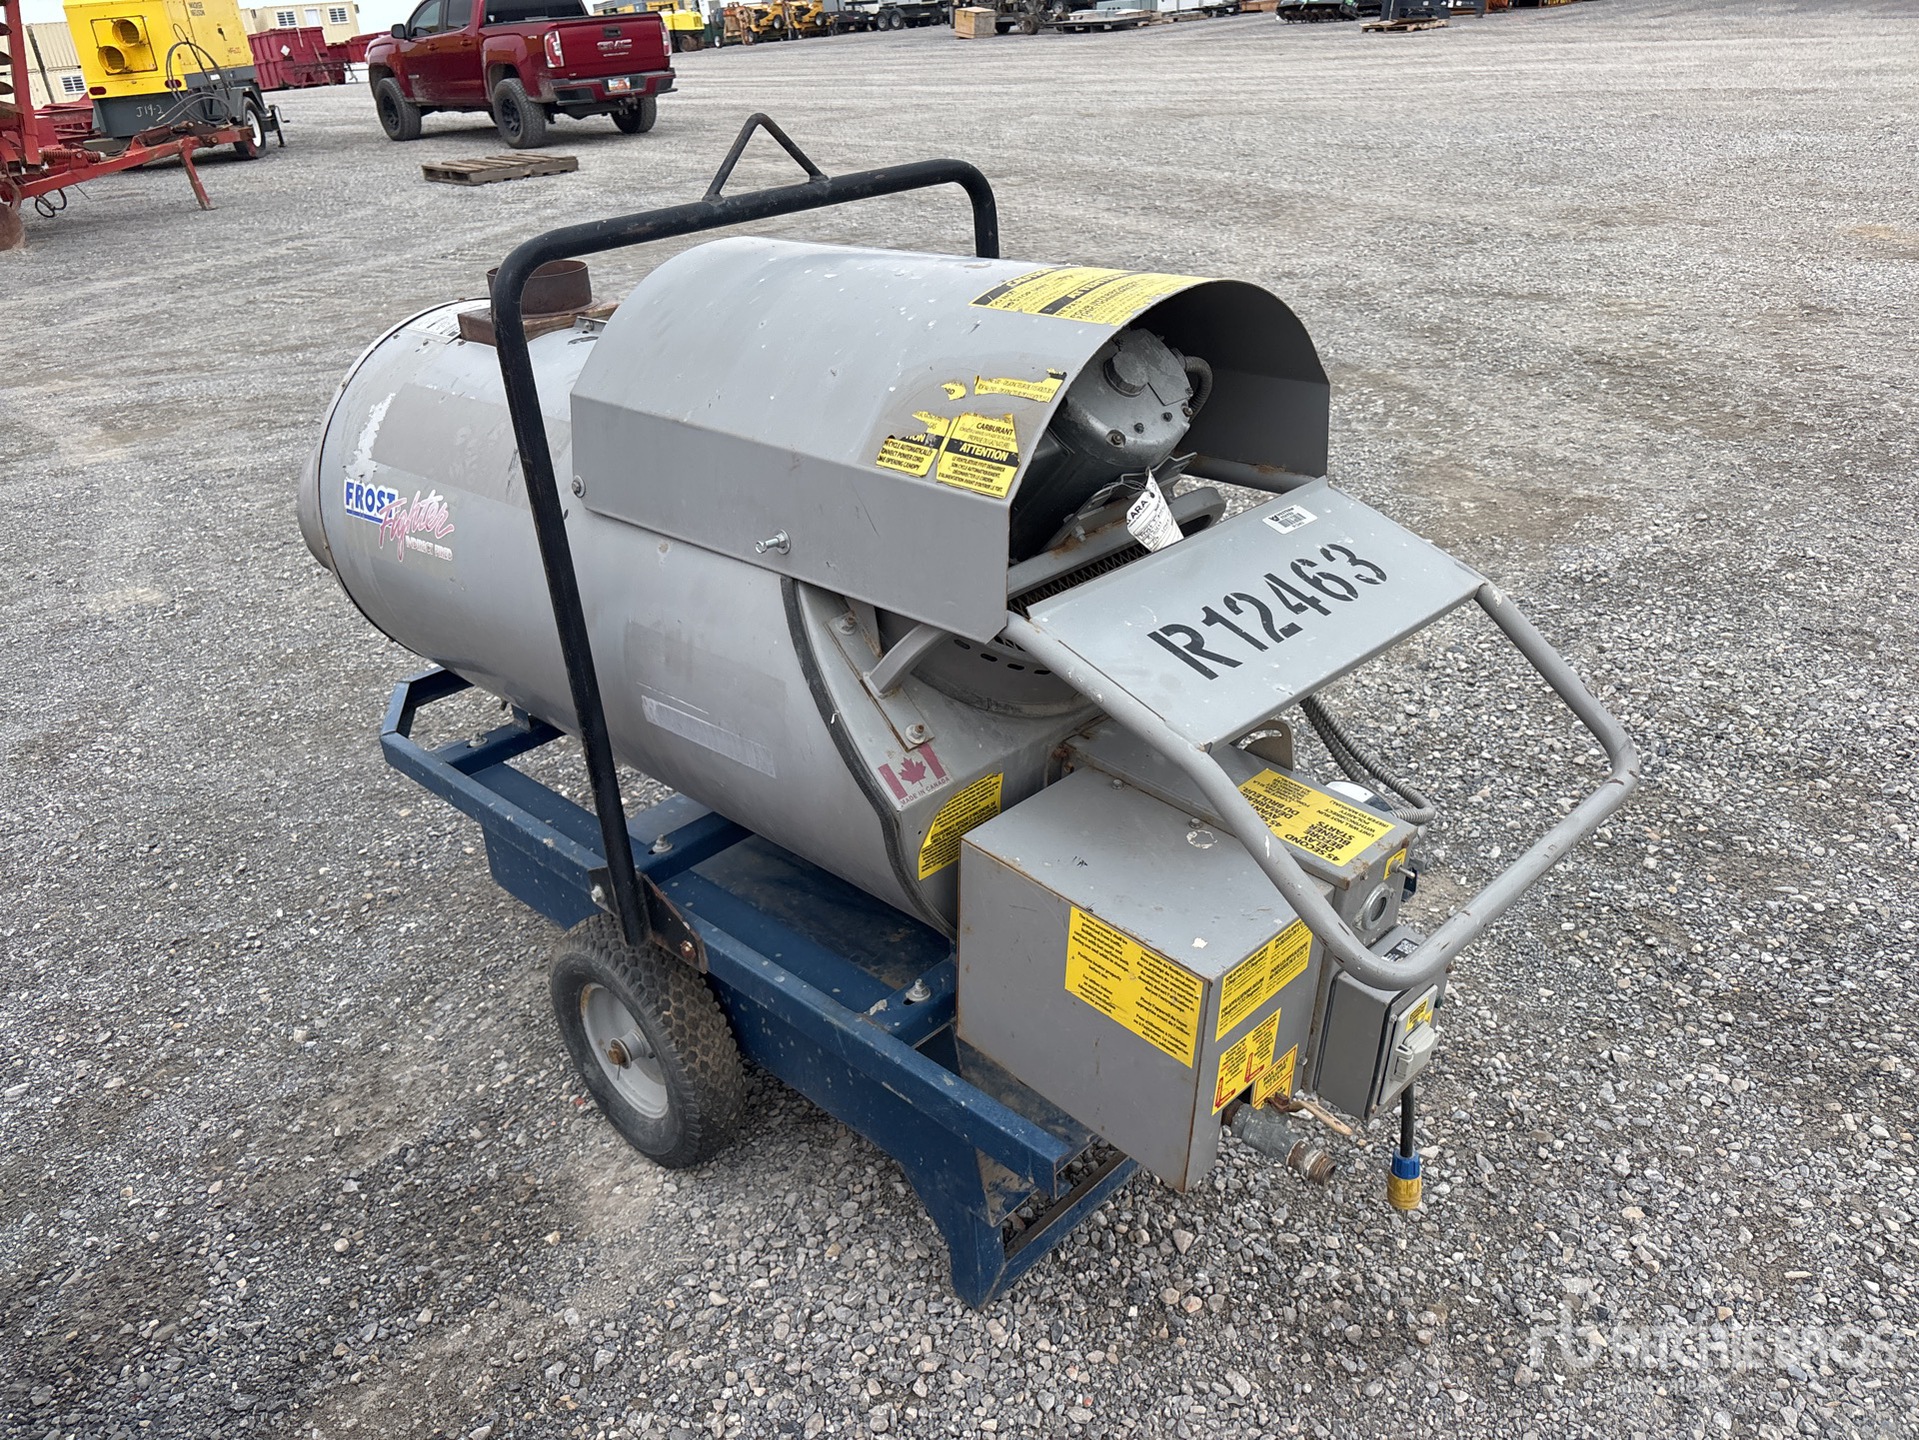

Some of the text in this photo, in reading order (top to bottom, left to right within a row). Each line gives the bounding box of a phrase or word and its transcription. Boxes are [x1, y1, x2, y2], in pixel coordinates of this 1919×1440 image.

[597, 39, 632, 50] GMC
[976, 422, 1013, 436] CARBURANT
[959, 442, 1010, 462] ATTENTION
[345, 481, 397, 518] FROST
[379, 489, 455, 562] Fighter
[1147, 543, 1387, 680] R12463
[901, 793, 918, 805] MADE
[925, 776, 950, 792] CANADA
[1256, 812, 1271, 822] SE
[1284, 807, 1300, 816] DU
[1338, 810, 1370, 825] POLARITY
[1316, 810, 1375, 838] UNIT WILL NOT RUN
[1316, 821, 1355, 840] STARTS
[1300, 835, 1335, 852] DELAY
[1303, 828, 1344, 850] BEFORE
[1308, 824, 1351, 846] BURNER
[1284, 833, 1340, 861] 45 SECOND
